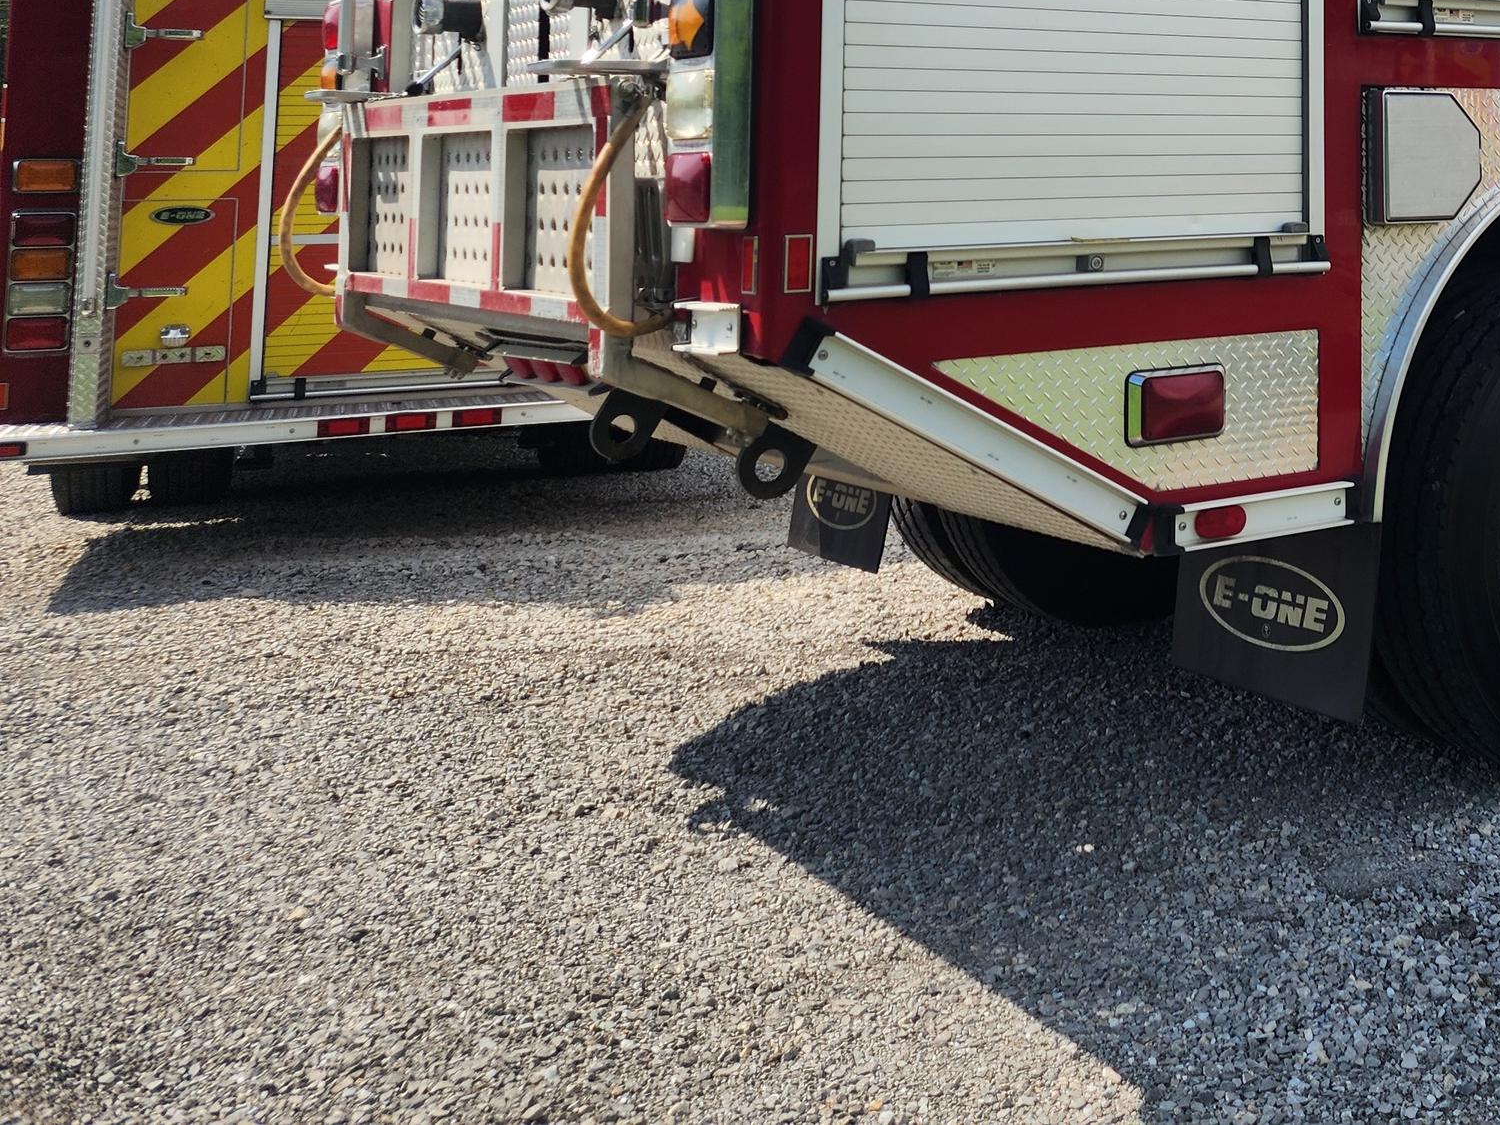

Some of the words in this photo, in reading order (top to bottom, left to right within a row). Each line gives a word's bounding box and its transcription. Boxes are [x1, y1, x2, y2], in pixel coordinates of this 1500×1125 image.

[159, 210, 207, 220] E-ONE
[812, 478, 873, 515] E-ONE
[1213, 574, 1329, 633] E-ONE
